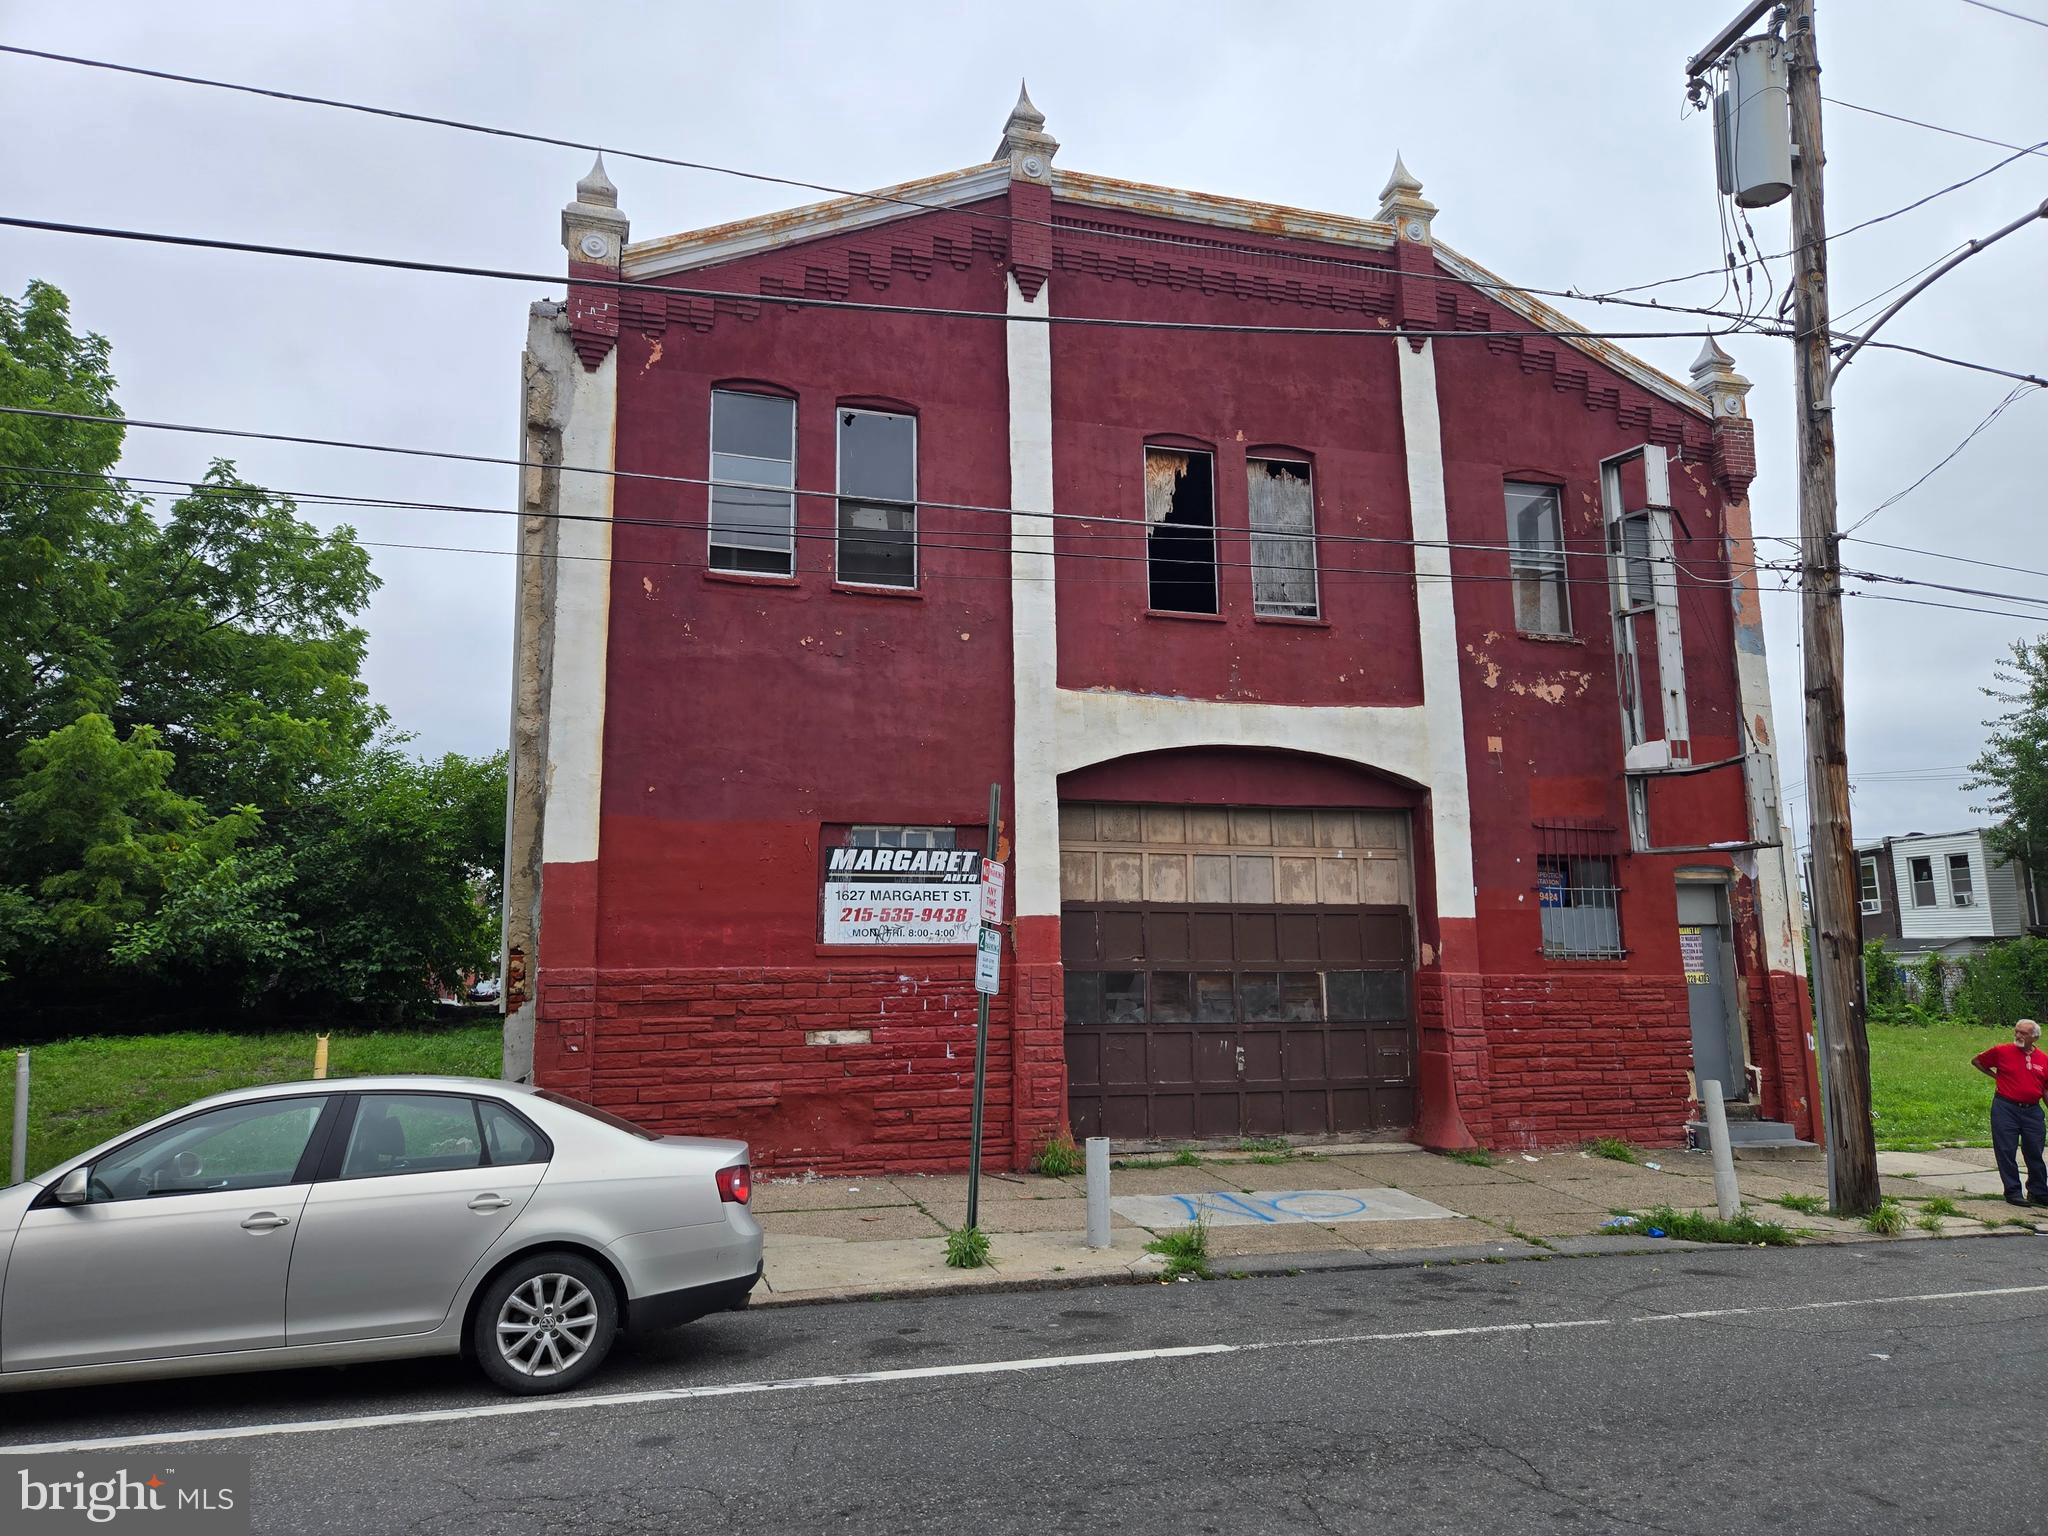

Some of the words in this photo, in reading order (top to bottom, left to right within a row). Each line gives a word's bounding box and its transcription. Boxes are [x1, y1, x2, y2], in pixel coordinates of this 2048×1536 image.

[829, 848, 978, 872] MARGARET
[943, 873, 978, 882] AUTO
[835, 890, 866, 901] 1627
[870, 890, 949, 901] MARGARET
[953, 890, 972, 902] ST.
[839, 907, 967, 923] 215-535-9438
[979, 931, 985, 948] 2
